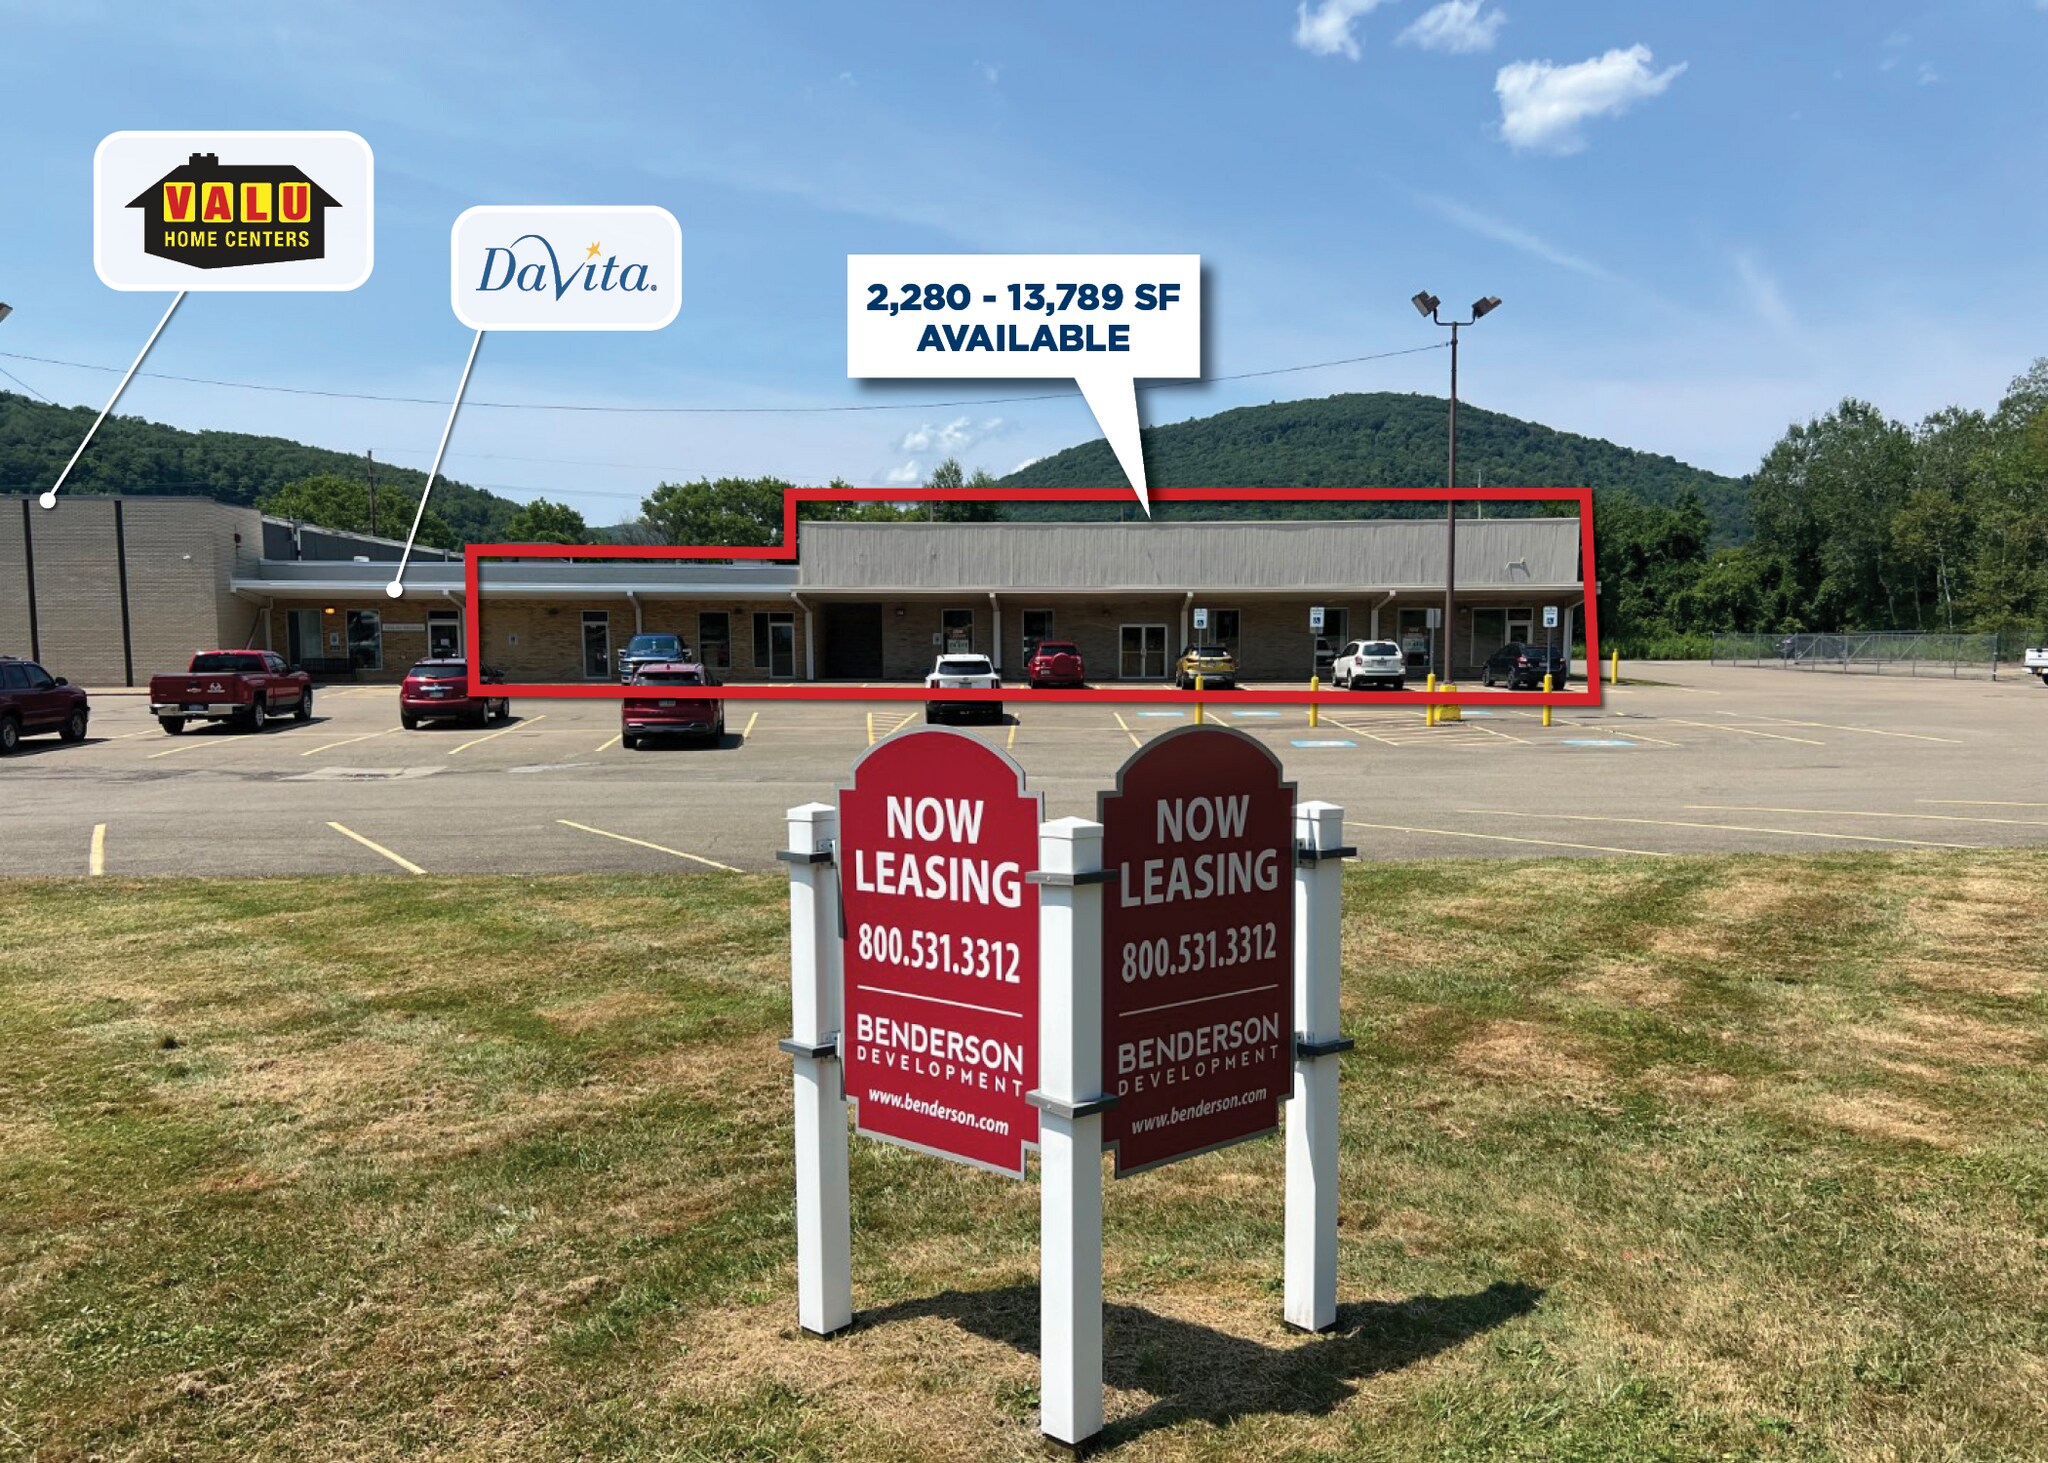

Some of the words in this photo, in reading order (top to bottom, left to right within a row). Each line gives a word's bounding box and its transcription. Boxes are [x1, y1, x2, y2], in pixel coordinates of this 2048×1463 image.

[886, 795, 985, 845] NOW
[1156, 794, 1250, 844] NOW
[854, 849, 1022, 909] LEASING
[1120, 848, 1278, 908] LEASING
[858, 922, 1021, 985] 800.531.3312
[1121, 921, 1277, 984] 800.531.3312
[857, 1013, 1024, 1076] BENDERSON
[1118, 1011, 1279, 1073] BENDERSON
[1118, 1043, 1279, 1095] DEVELOPMENT
[857, 1044, 1024, 1097] DEVELOPMENT
[868, 1086, 1009, 1137] www.benderson.com
[1130, 1085, 1267, 1135] www.benderson.com
